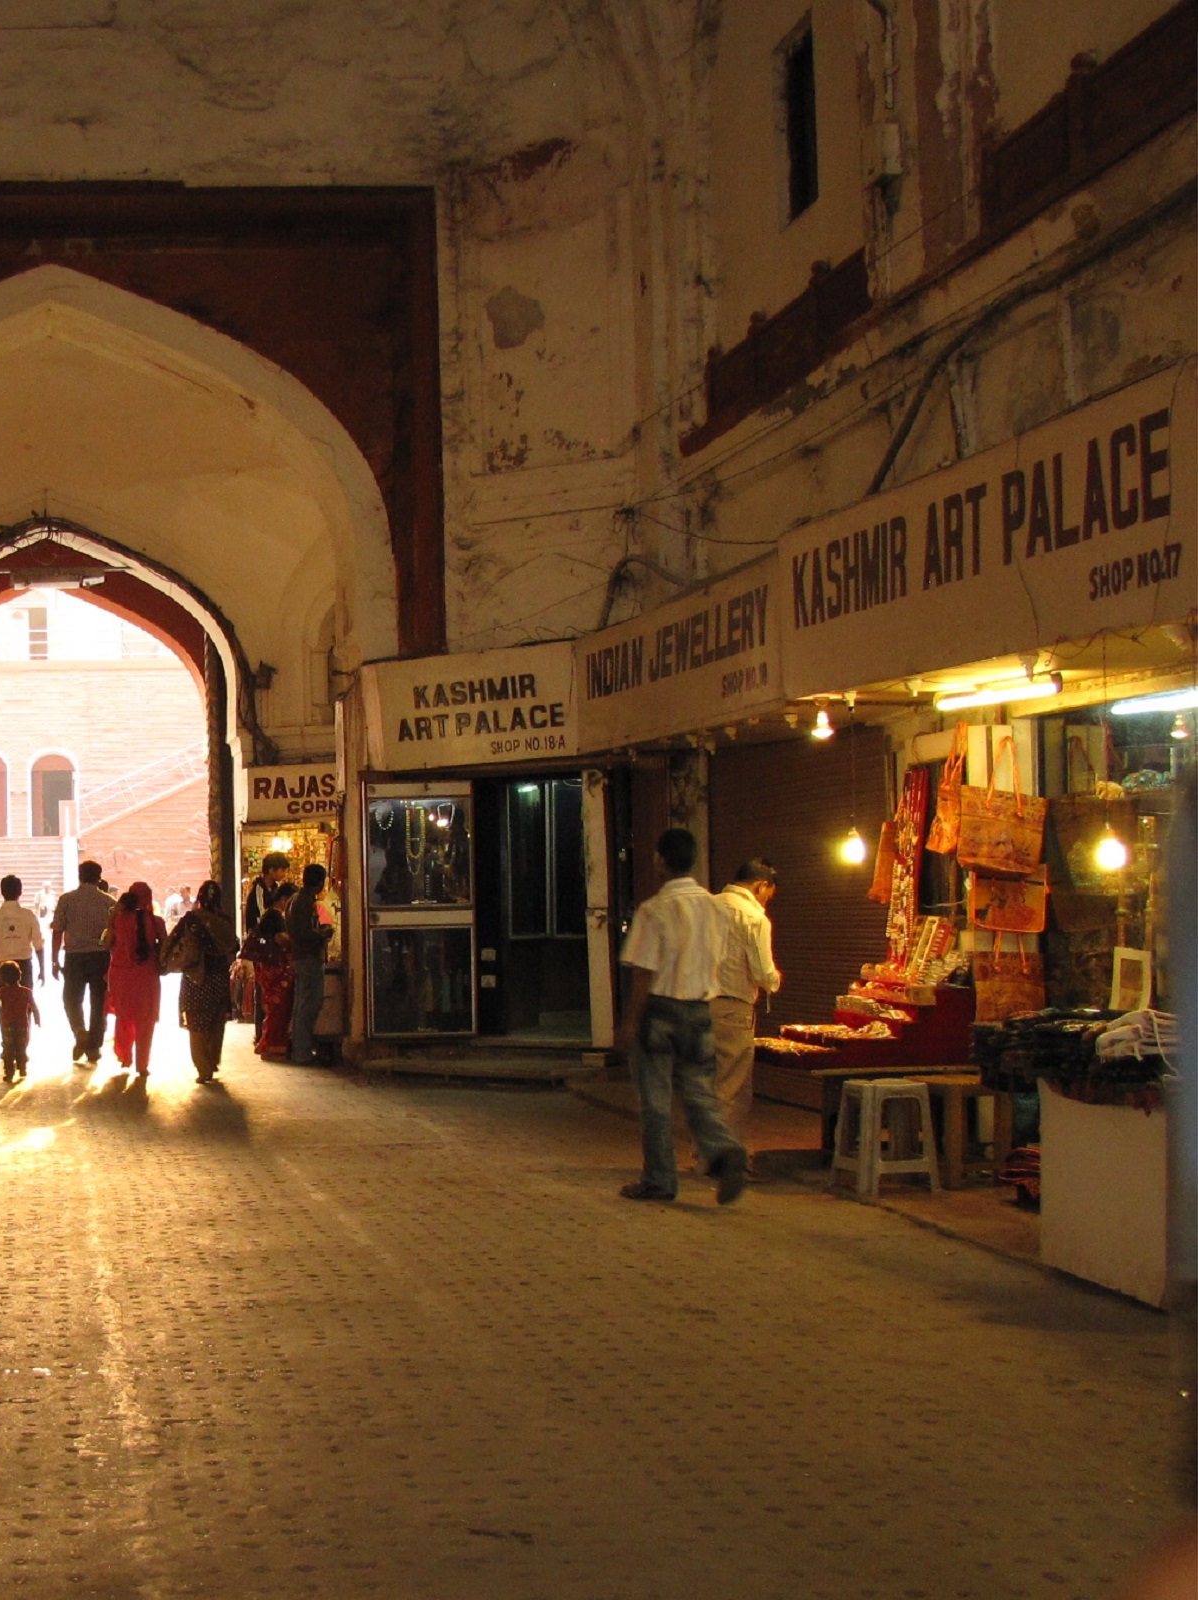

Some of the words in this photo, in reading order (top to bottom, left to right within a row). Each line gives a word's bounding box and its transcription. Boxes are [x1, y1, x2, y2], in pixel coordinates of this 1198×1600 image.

[792, 515, 907, 630] KASHMIR
[922, 482, 988, 591] ART
[1001, 407, 1171, 567] PALACE
[1089, 556, 1134, 601] SHOP
[586, 635, 644, 700] INDIAN
[648, 584, 768, 683] JEWELLERY
[413, 674, 537, 710] KASHMIR
[398, 712, 448, 742] ART
[455, 702, 565, 737] PALACE
[490, 739, 521, 755] SHOP
[253, 773, 336, 800] RAJAS
